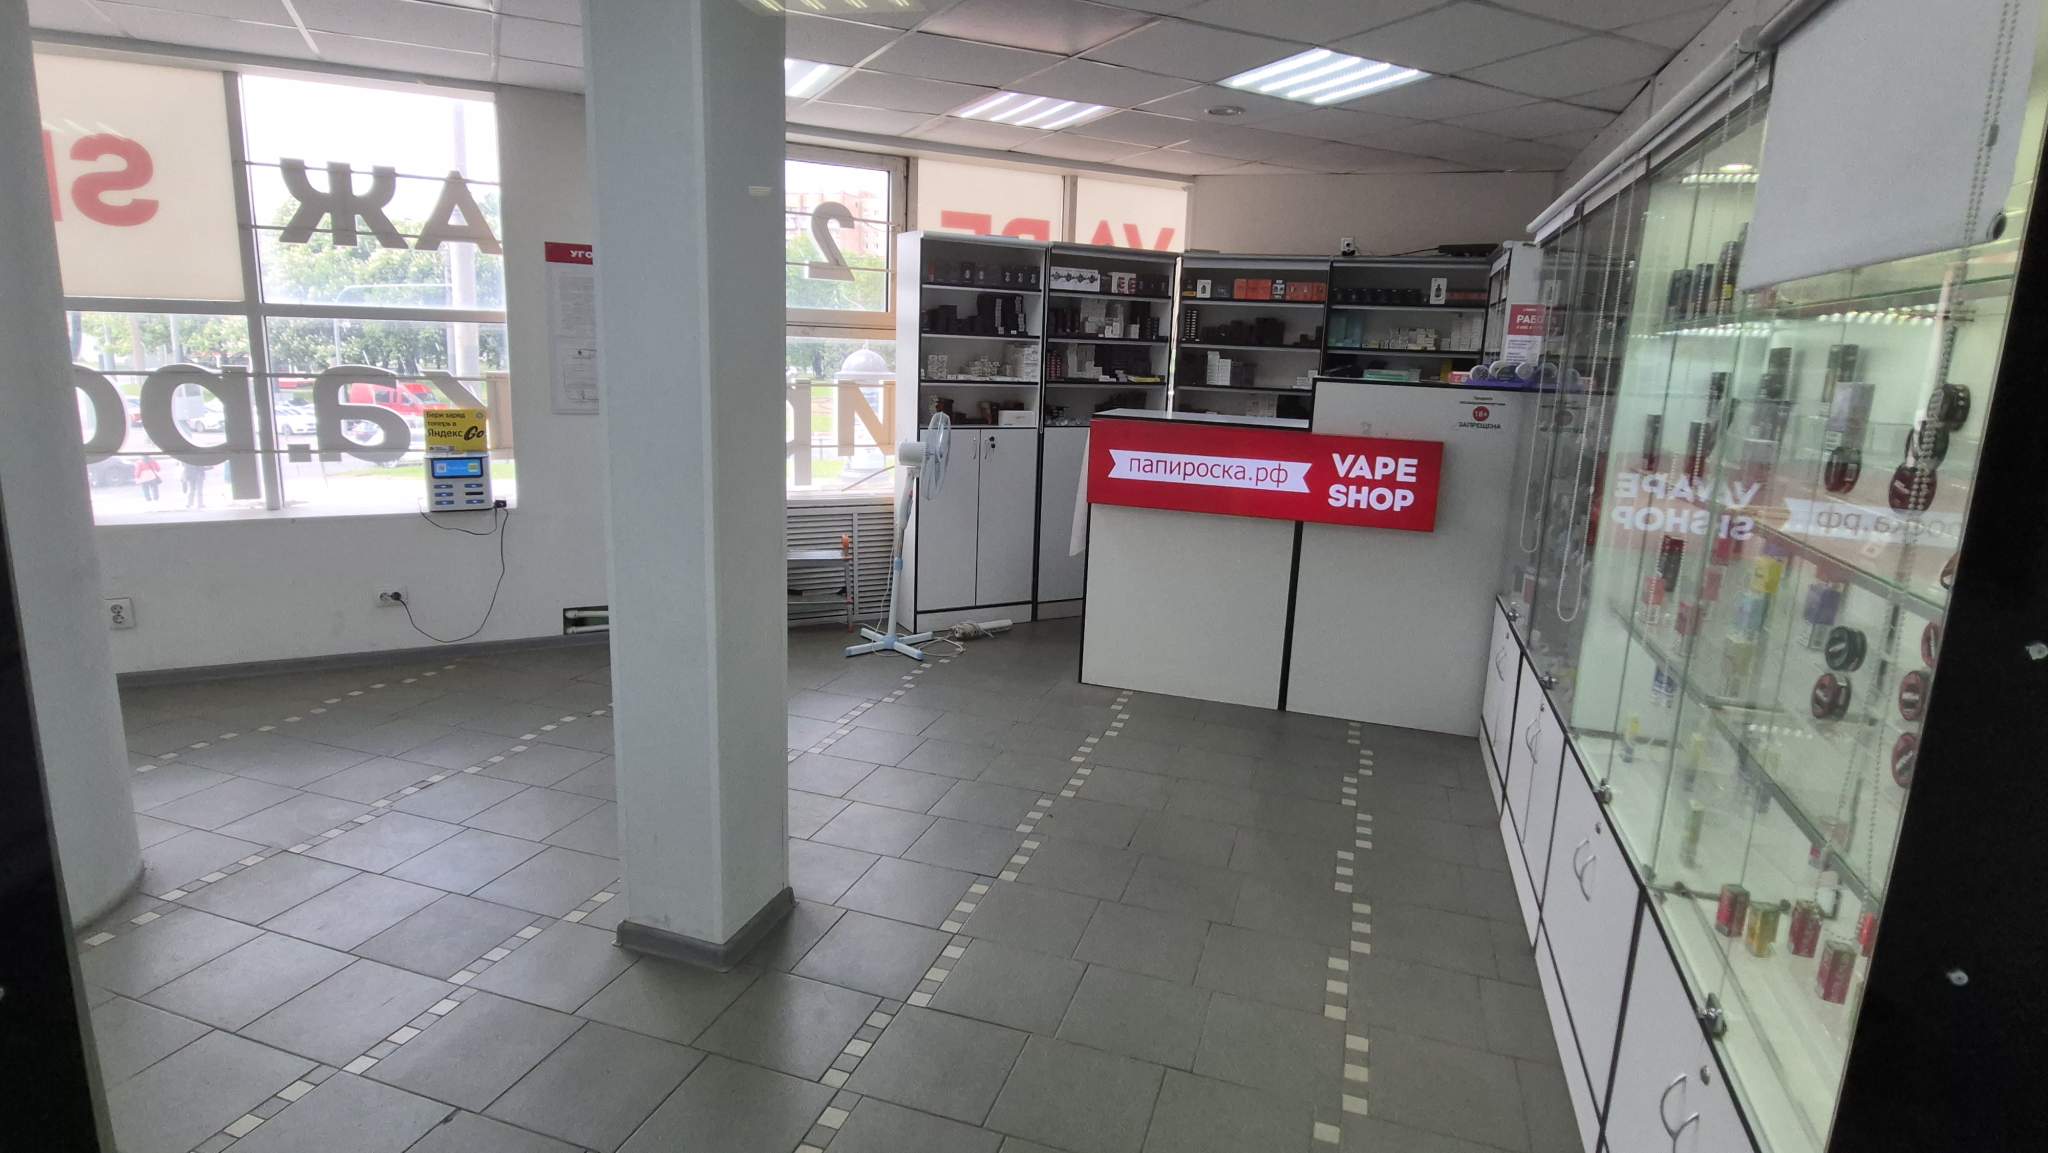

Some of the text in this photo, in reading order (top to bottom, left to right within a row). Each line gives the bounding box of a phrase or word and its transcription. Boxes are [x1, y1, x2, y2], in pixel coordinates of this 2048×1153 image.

[428, 426, 485, 440] Яндекс Go
[1129, 456, 1289, 488] папироска.рф
[1332, 453, 1418, 482] VAPE
[1328, 484, 1415, 512] SHOP
